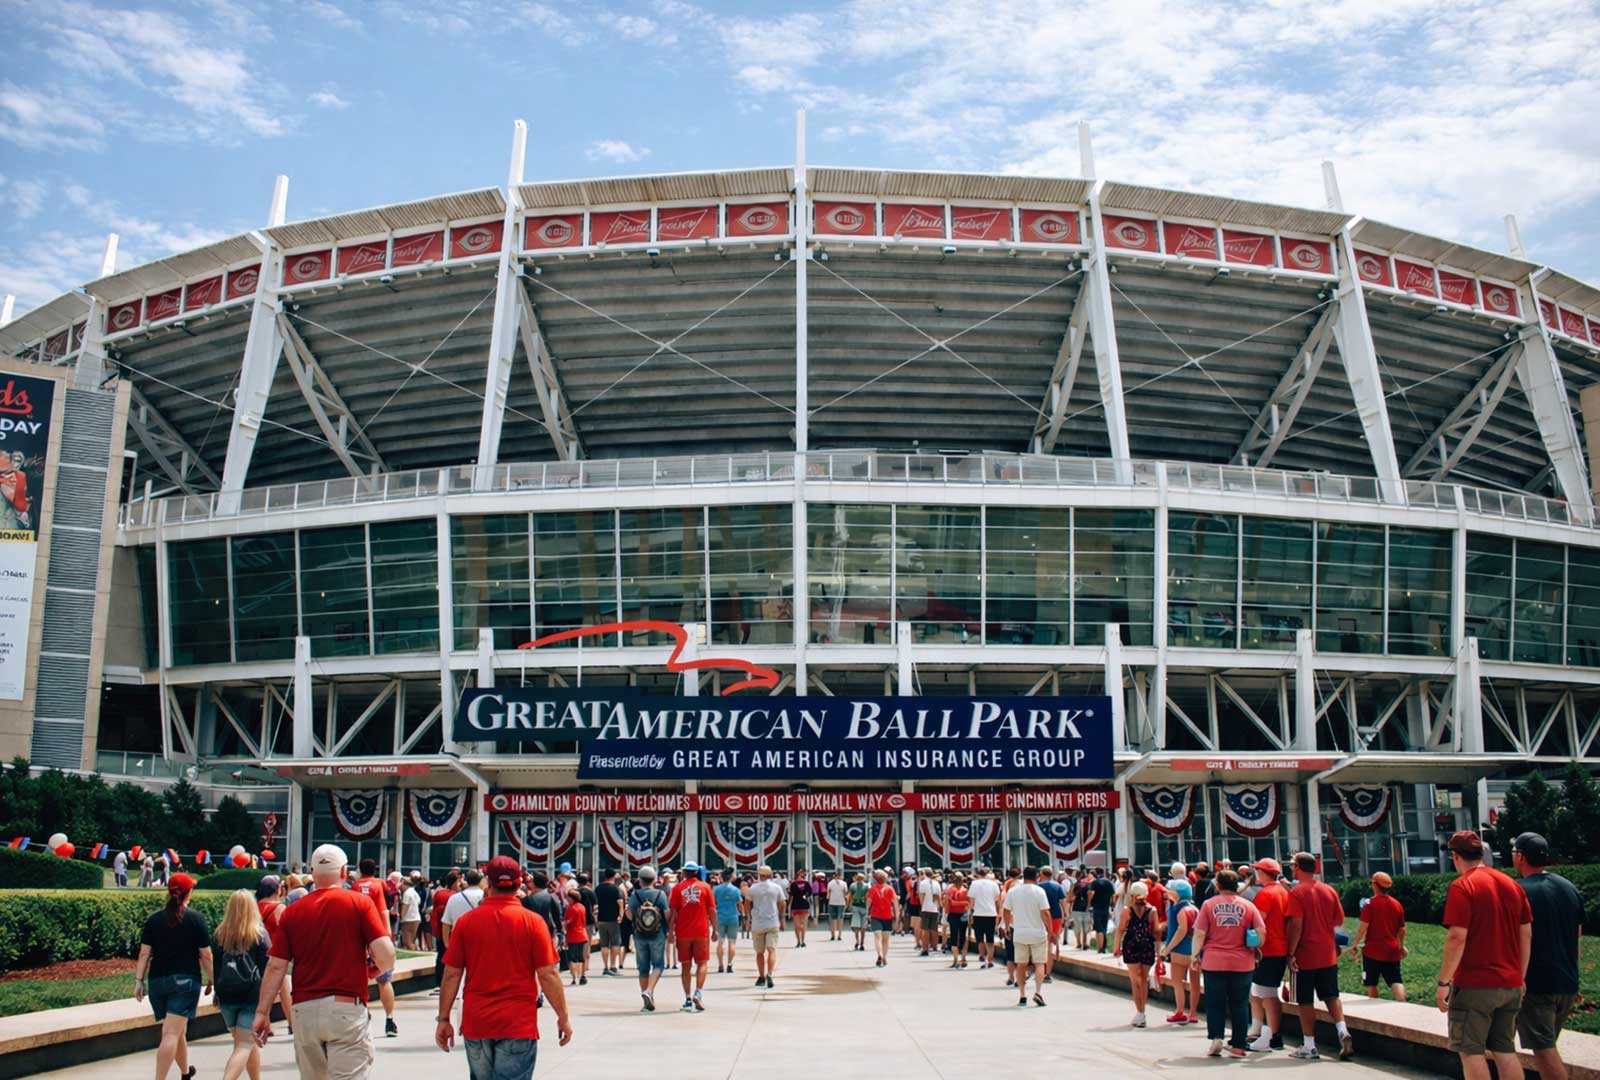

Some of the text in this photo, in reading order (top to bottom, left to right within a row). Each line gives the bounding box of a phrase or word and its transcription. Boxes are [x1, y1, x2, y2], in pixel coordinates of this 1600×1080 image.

[467, 694, 611, 731] GREAT
[596, 702, 828, 740] AMERICAN
[844, 701, 960, 740] BALL
[672, 750, 740, 768] GREAT
[751, 750, 864, 768] AMERICAN
[877, 750, 1003, 768] INSURANCE
[1013, 749, 1085, 767] GROUP
[511, 795, 570, 811] HAMILTON
[575, 794, 619, 811] COUNTY
[625, 795, 690, 811] WELCOMES
[699, 794, 721, 811] YOU
[748, 794, 768, 810] 100
[772, 794, 793, 811] JOE
[798, 794, 852, 810] NUXHALL
[857, 794, 883, 810] WAY
[922, 793, 955, 810] HOME
[960, 793, 976, 810] OF
[979, 793, 1000, 809] THE
[1005, 792, 1073, 809] CINCINNATI
[1077, 792, 1107, 808] REDS
